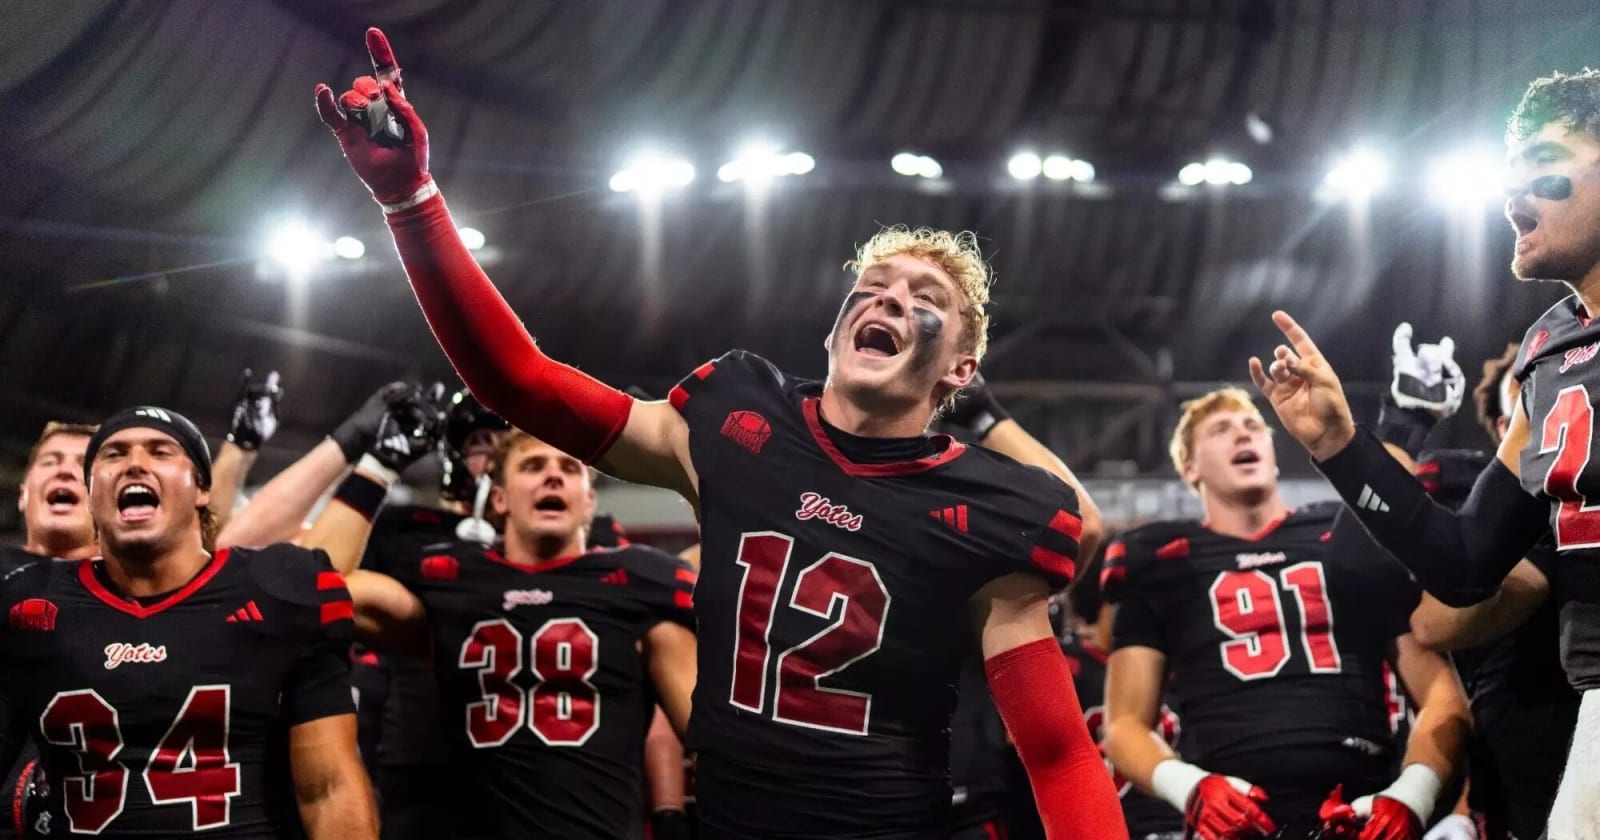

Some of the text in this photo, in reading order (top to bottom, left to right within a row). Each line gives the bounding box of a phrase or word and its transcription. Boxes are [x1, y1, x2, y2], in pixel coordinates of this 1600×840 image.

[795, 491, 864, 531] Yotes
[104, 642, 167, 670] Yotes
[458, 616, 600, 749] 38
[729, 530, 892, 736] 12
[1208, 560, 1342, 682] 91
[40, 684, 241, 835] 34
